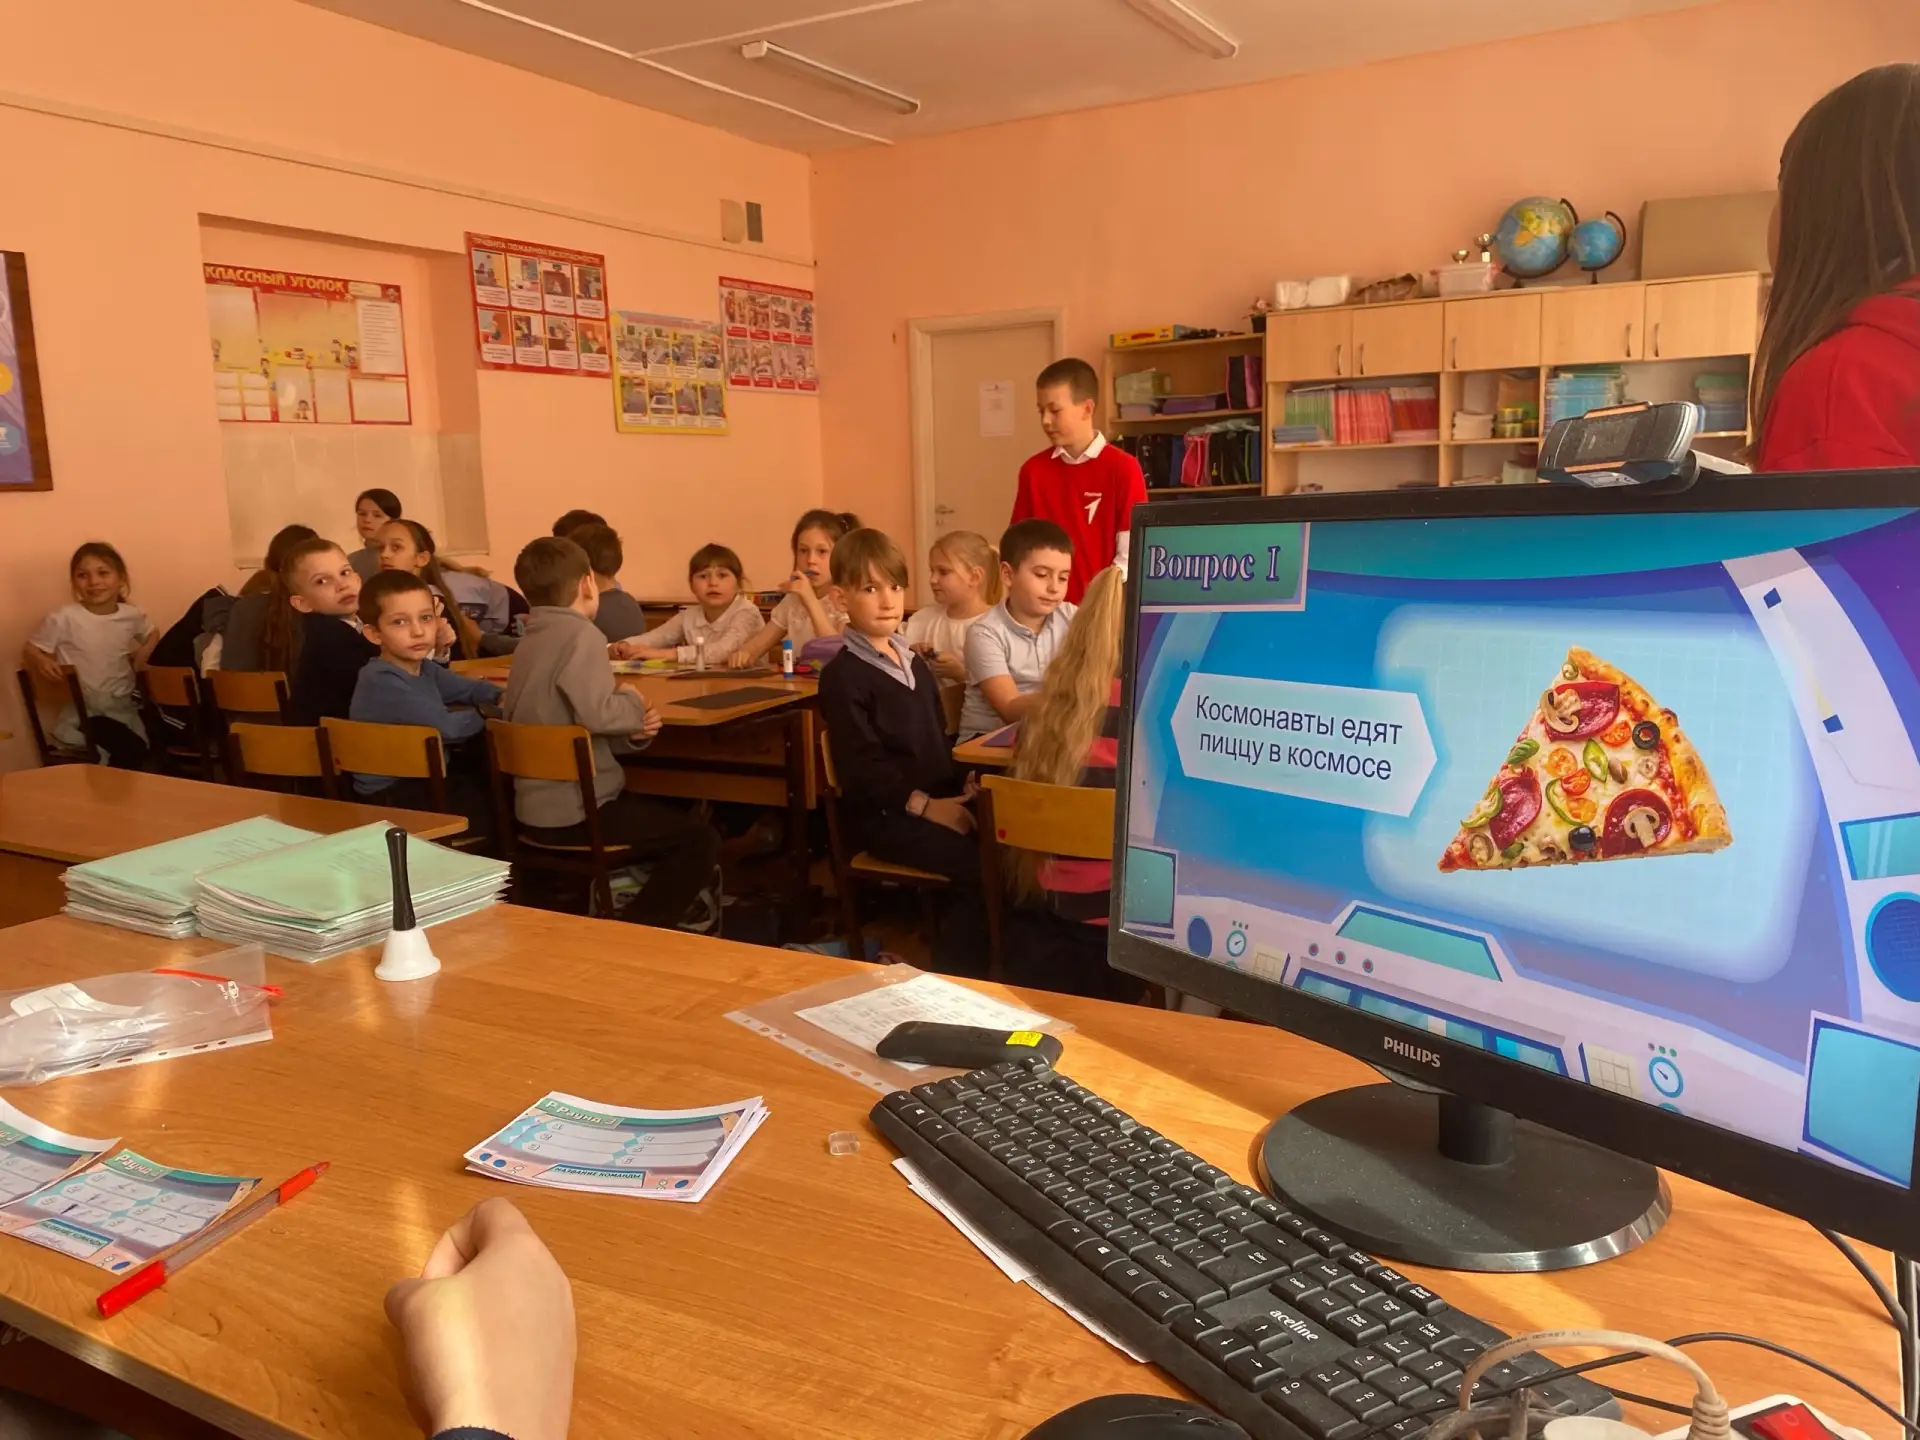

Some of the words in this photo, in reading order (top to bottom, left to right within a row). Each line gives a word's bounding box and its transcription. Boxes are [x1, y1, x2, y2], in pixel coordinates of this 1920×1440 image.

[204, 265, 286, 286] КЛАССНЫЙ
[290, 275, 346, 293] УГОЛОК
[1147, 545, 1255, 590] Вопрос
[1196, 694, 1335, 736] Космонавты
[1341, 718, 1402, 745] едят
[1199, 732, 1264, 765] пиццу
[1269, 743, 1281, 762] в
[1287, 746, 1392, 780] космосе
[1383, 1036, 1440, 1068] PHILIPS
[554, 1167, 597, 1178] НАЗВАНИЕ
[598, 1171, 641, 1180] КОМАНДЫ
[1269, 1310, 1319, 1341] aceline
